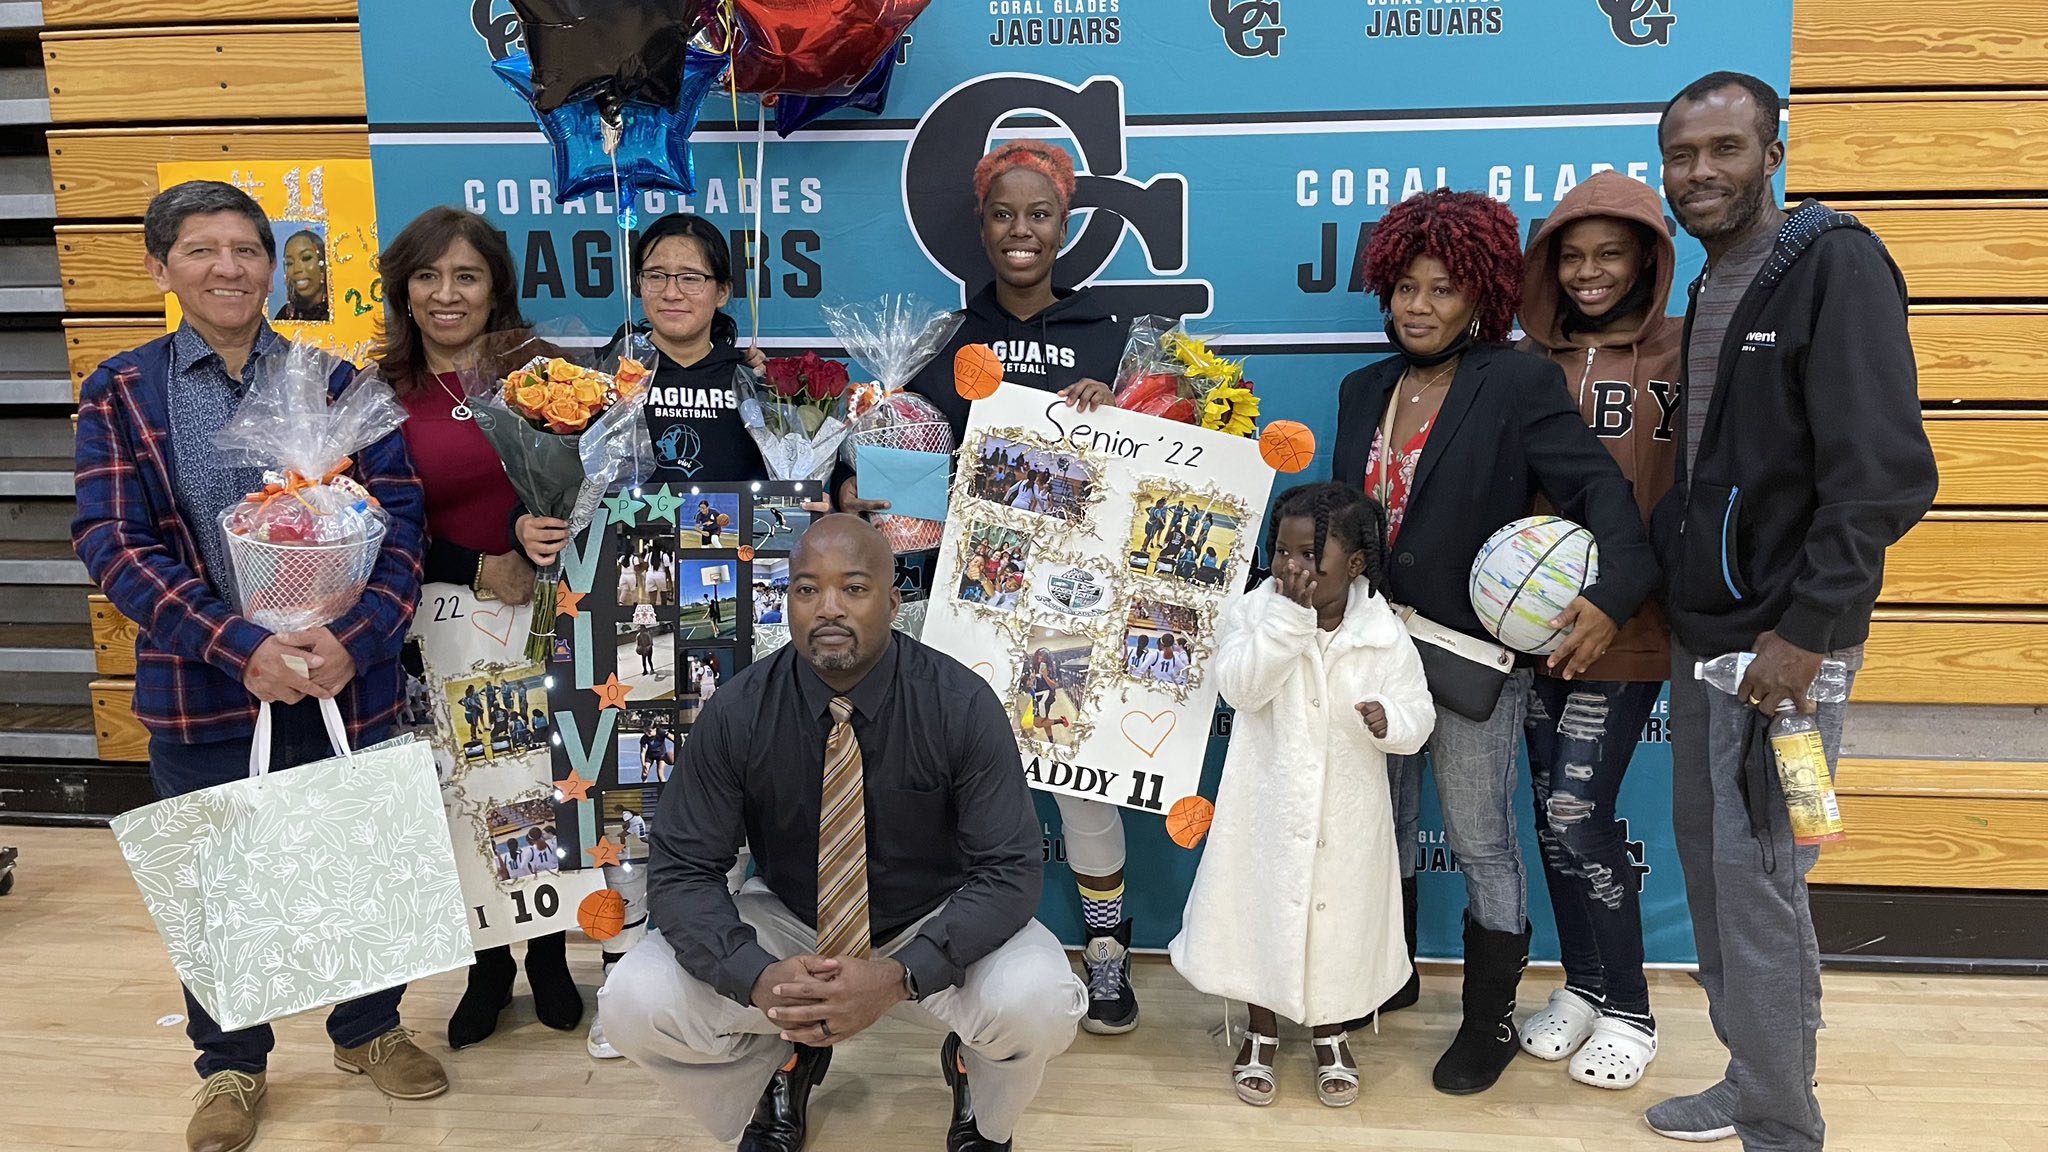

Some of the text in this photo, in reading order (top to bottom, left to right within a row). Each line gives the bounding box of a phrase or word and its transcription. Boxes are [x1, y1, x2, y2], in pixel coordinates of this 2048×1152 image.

[989, 0, 1120, 15] CORAL GLADES
[1365, 6, 1503, 38] JAGUARS
[989, 17, 1121, 47] JAGUARS
[644, 387, 739, 409] AGUARS
[655, 408, 718, 419] BASKETBALL
[1046, 400, 1149, 459] Senior
[1022, 756, 1165, 811] ADDY 11
[510, 883, 560, 925] 10
